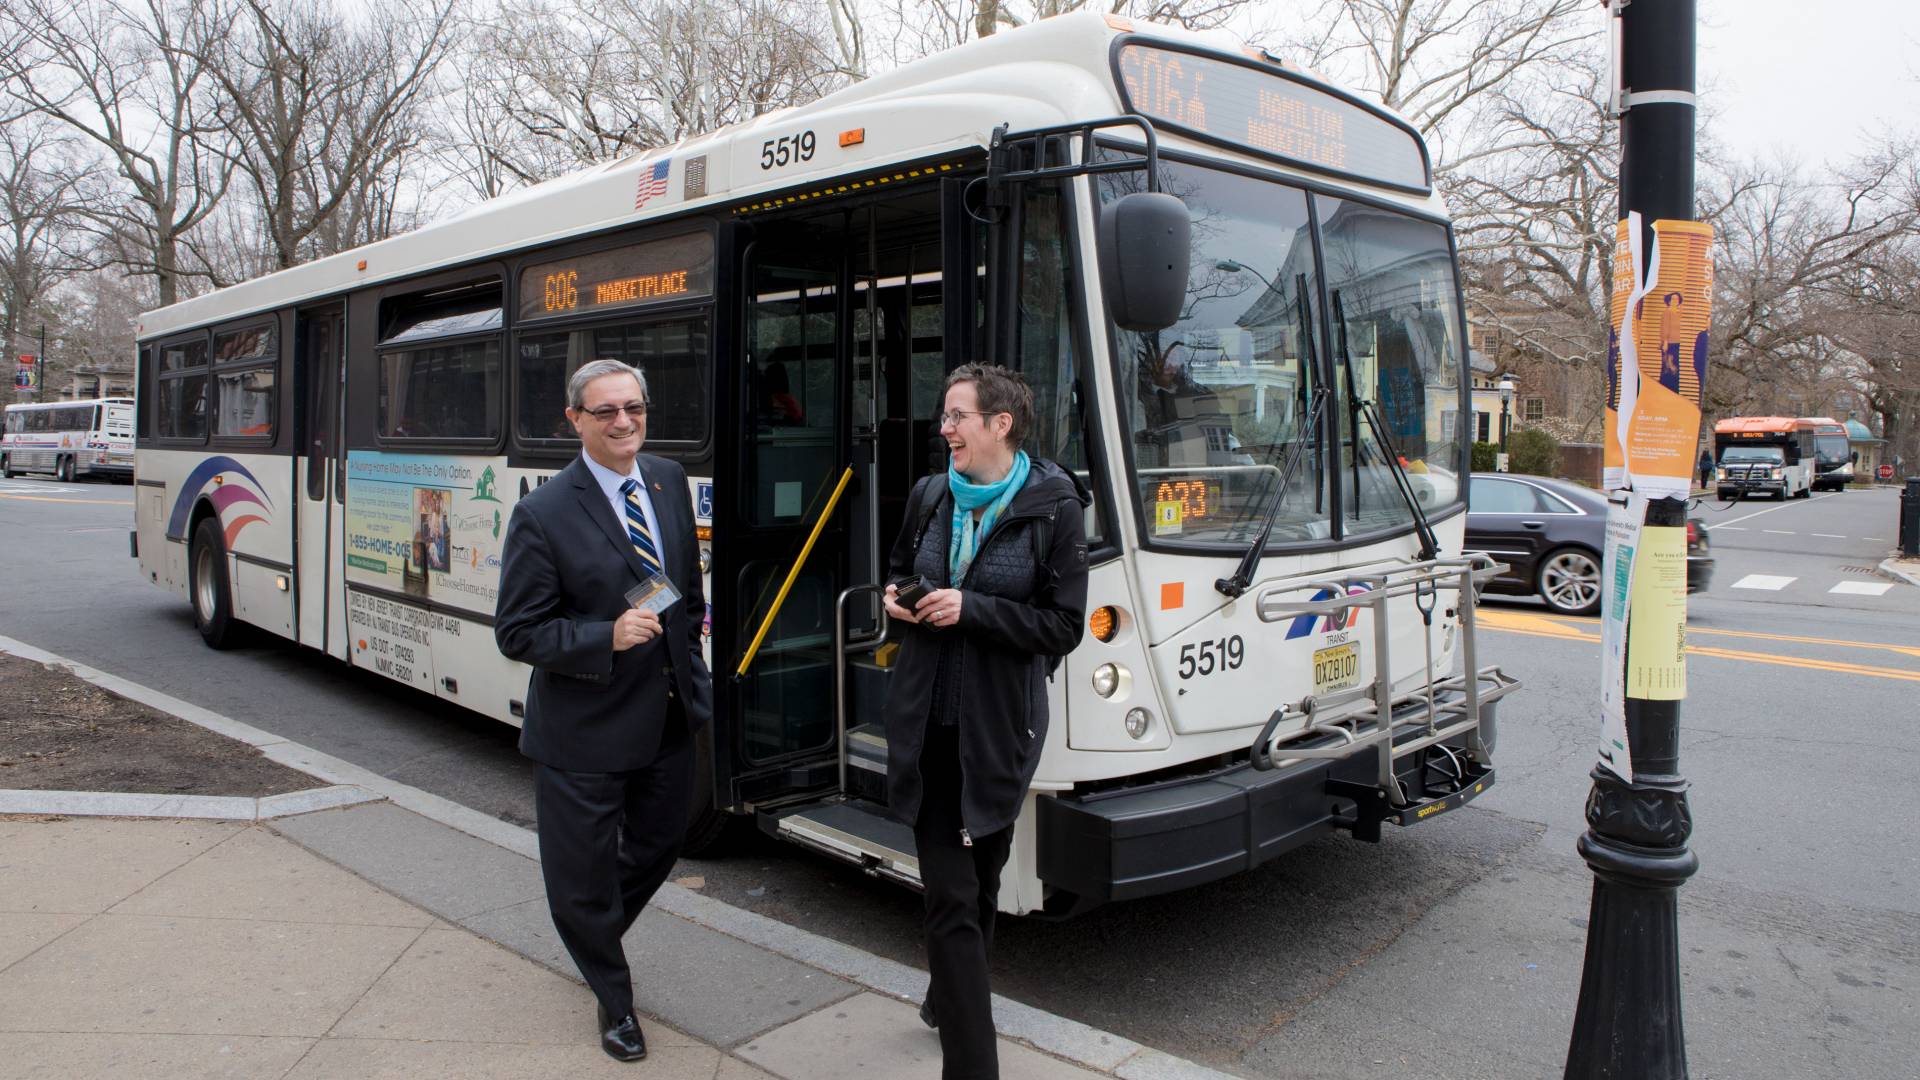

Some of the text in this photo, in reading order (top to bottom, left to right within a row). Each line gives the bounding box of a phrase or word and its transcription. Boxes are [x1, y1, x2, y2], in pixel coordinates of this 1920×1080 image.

[760, 130, 816, 170] 5519
[545, 271, 688, 311] 606 MARKETPLACE
[433, 464, 448, 479] Only
[449, 465, 473, 480] Option.
[371, 637, 378, 651] US
[379, 638, 389, 654] DOT
[1326, 632, 1349, 646] TRANSIT
[1178, 634, 1244, 680] 5519
